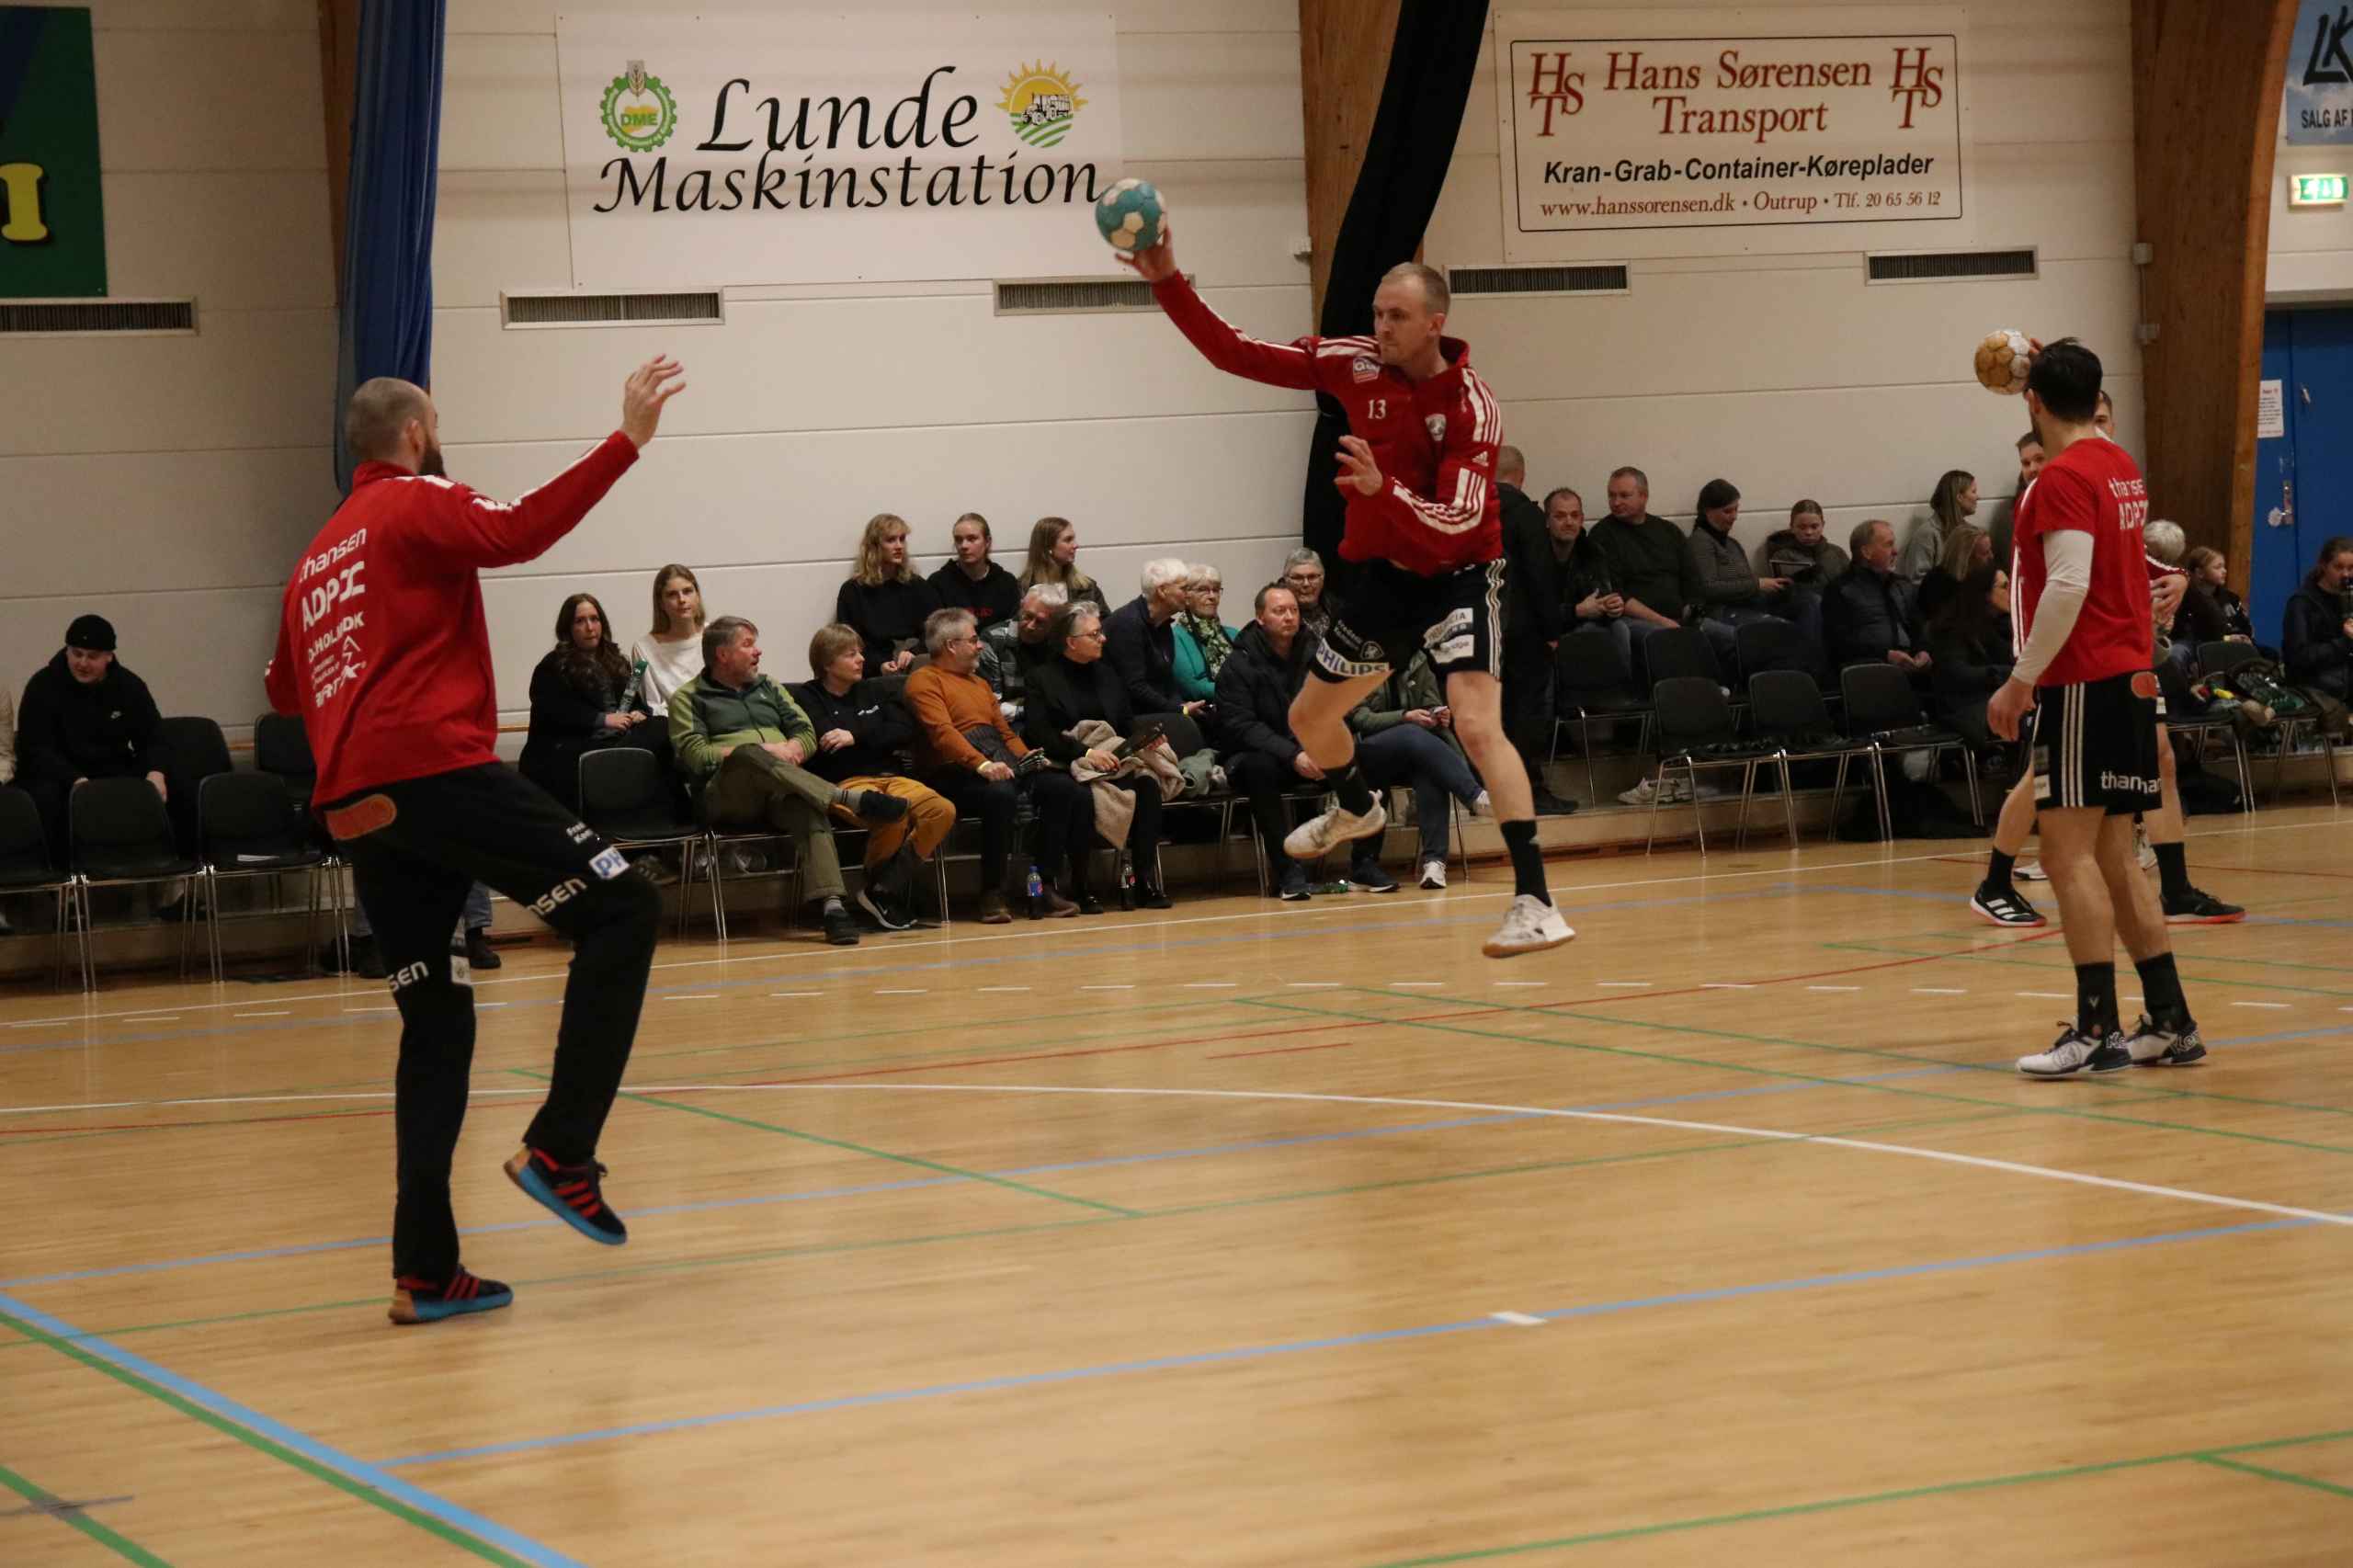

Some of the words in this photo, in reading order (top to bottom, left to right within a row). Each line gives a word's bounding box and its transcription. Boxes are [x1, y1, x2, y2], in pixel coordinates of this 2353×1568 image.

[1603, 51, 1701, 91] Hans
[1716, 49, 1872, 89] Sørensen
[620, 112, 659, 126] DME
[695, 65, 980, 152] Lunde
[1653, 95, 1829, 144] Transport
[2301, 108, 2331, 130] SALG
[2333, 108, 2348, 128] AF
[592, 148, 1104, 214] Maskinstation
[1540, 191, 1736, 217] www.hanssorensen.dk
[1754, 190, 1817, 214] Outrup
[1834, 192, 1860, 209] Tlf.
[1866, 192, 1882, 208] 20
[1885, 192, 1902, 207] 65
[1905, 191, 1923, 207] 56
[1927, 190, 1941, 206] 12
[1367, 398, 1387, 420] 13
